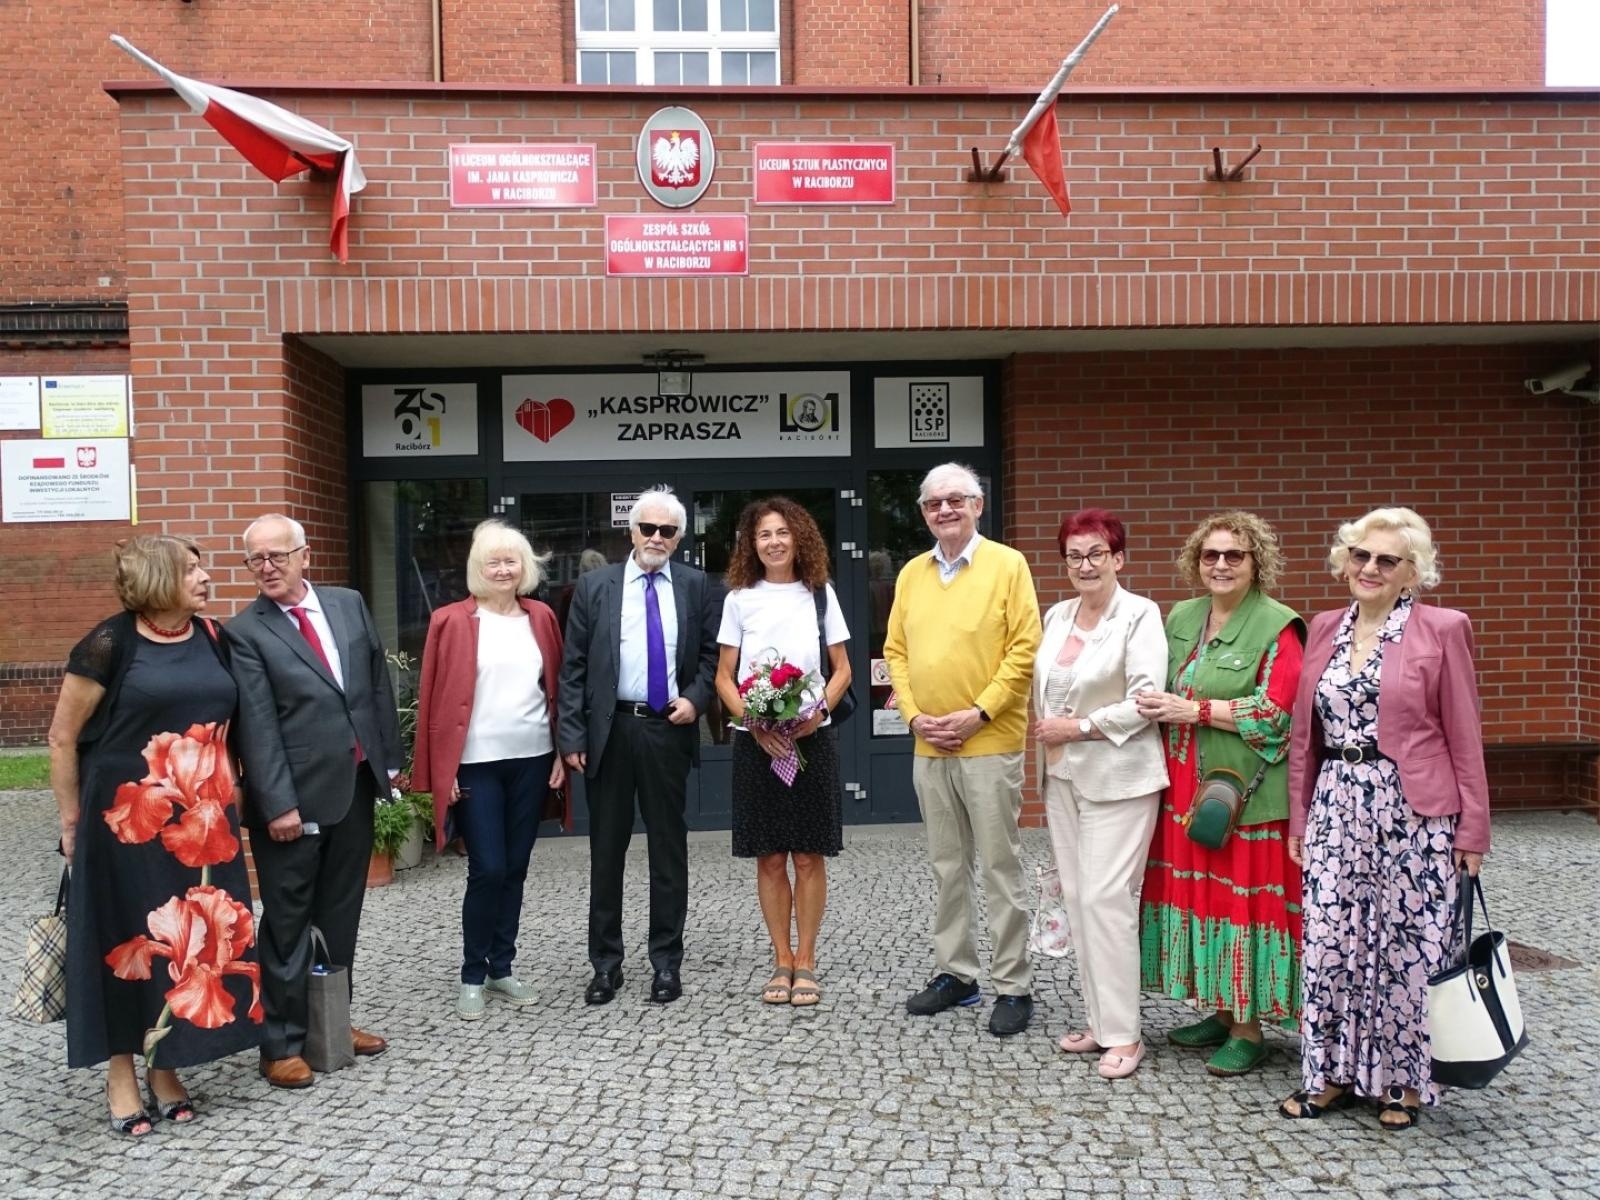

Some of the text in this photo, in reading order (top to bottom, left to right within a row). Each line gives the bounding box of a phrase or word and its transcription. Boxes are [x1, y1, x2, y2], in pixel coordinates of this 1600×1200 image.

[462, 154, 496, 166] LICEUM
[499, 151, 591, 168] OGÓLNOKSZTAŁCĄCE
[759, 159, 888, 171] LICEUM SZTUK PLASTYCZNYCH
[467, 171, 579, 184] IM. JANA KASPROWICZA
[792, 176, 855, 189] W RACIBORZU
[491, 187, 557, 201] W RACIBORZU
[643, 220, 711, 236] ZESPÓŁ SZKÓŁ
[610, 237, 744, 255] OGÓLNOKSZTAŁCĄCYCH NR 1
[644, 256, 711, 269] W RACIBORZU
[617, 421, 742, 441] ZAPRASZA
[915, 417, 944, 431] LSP
[395, 442, 431, 451] Racibórz
